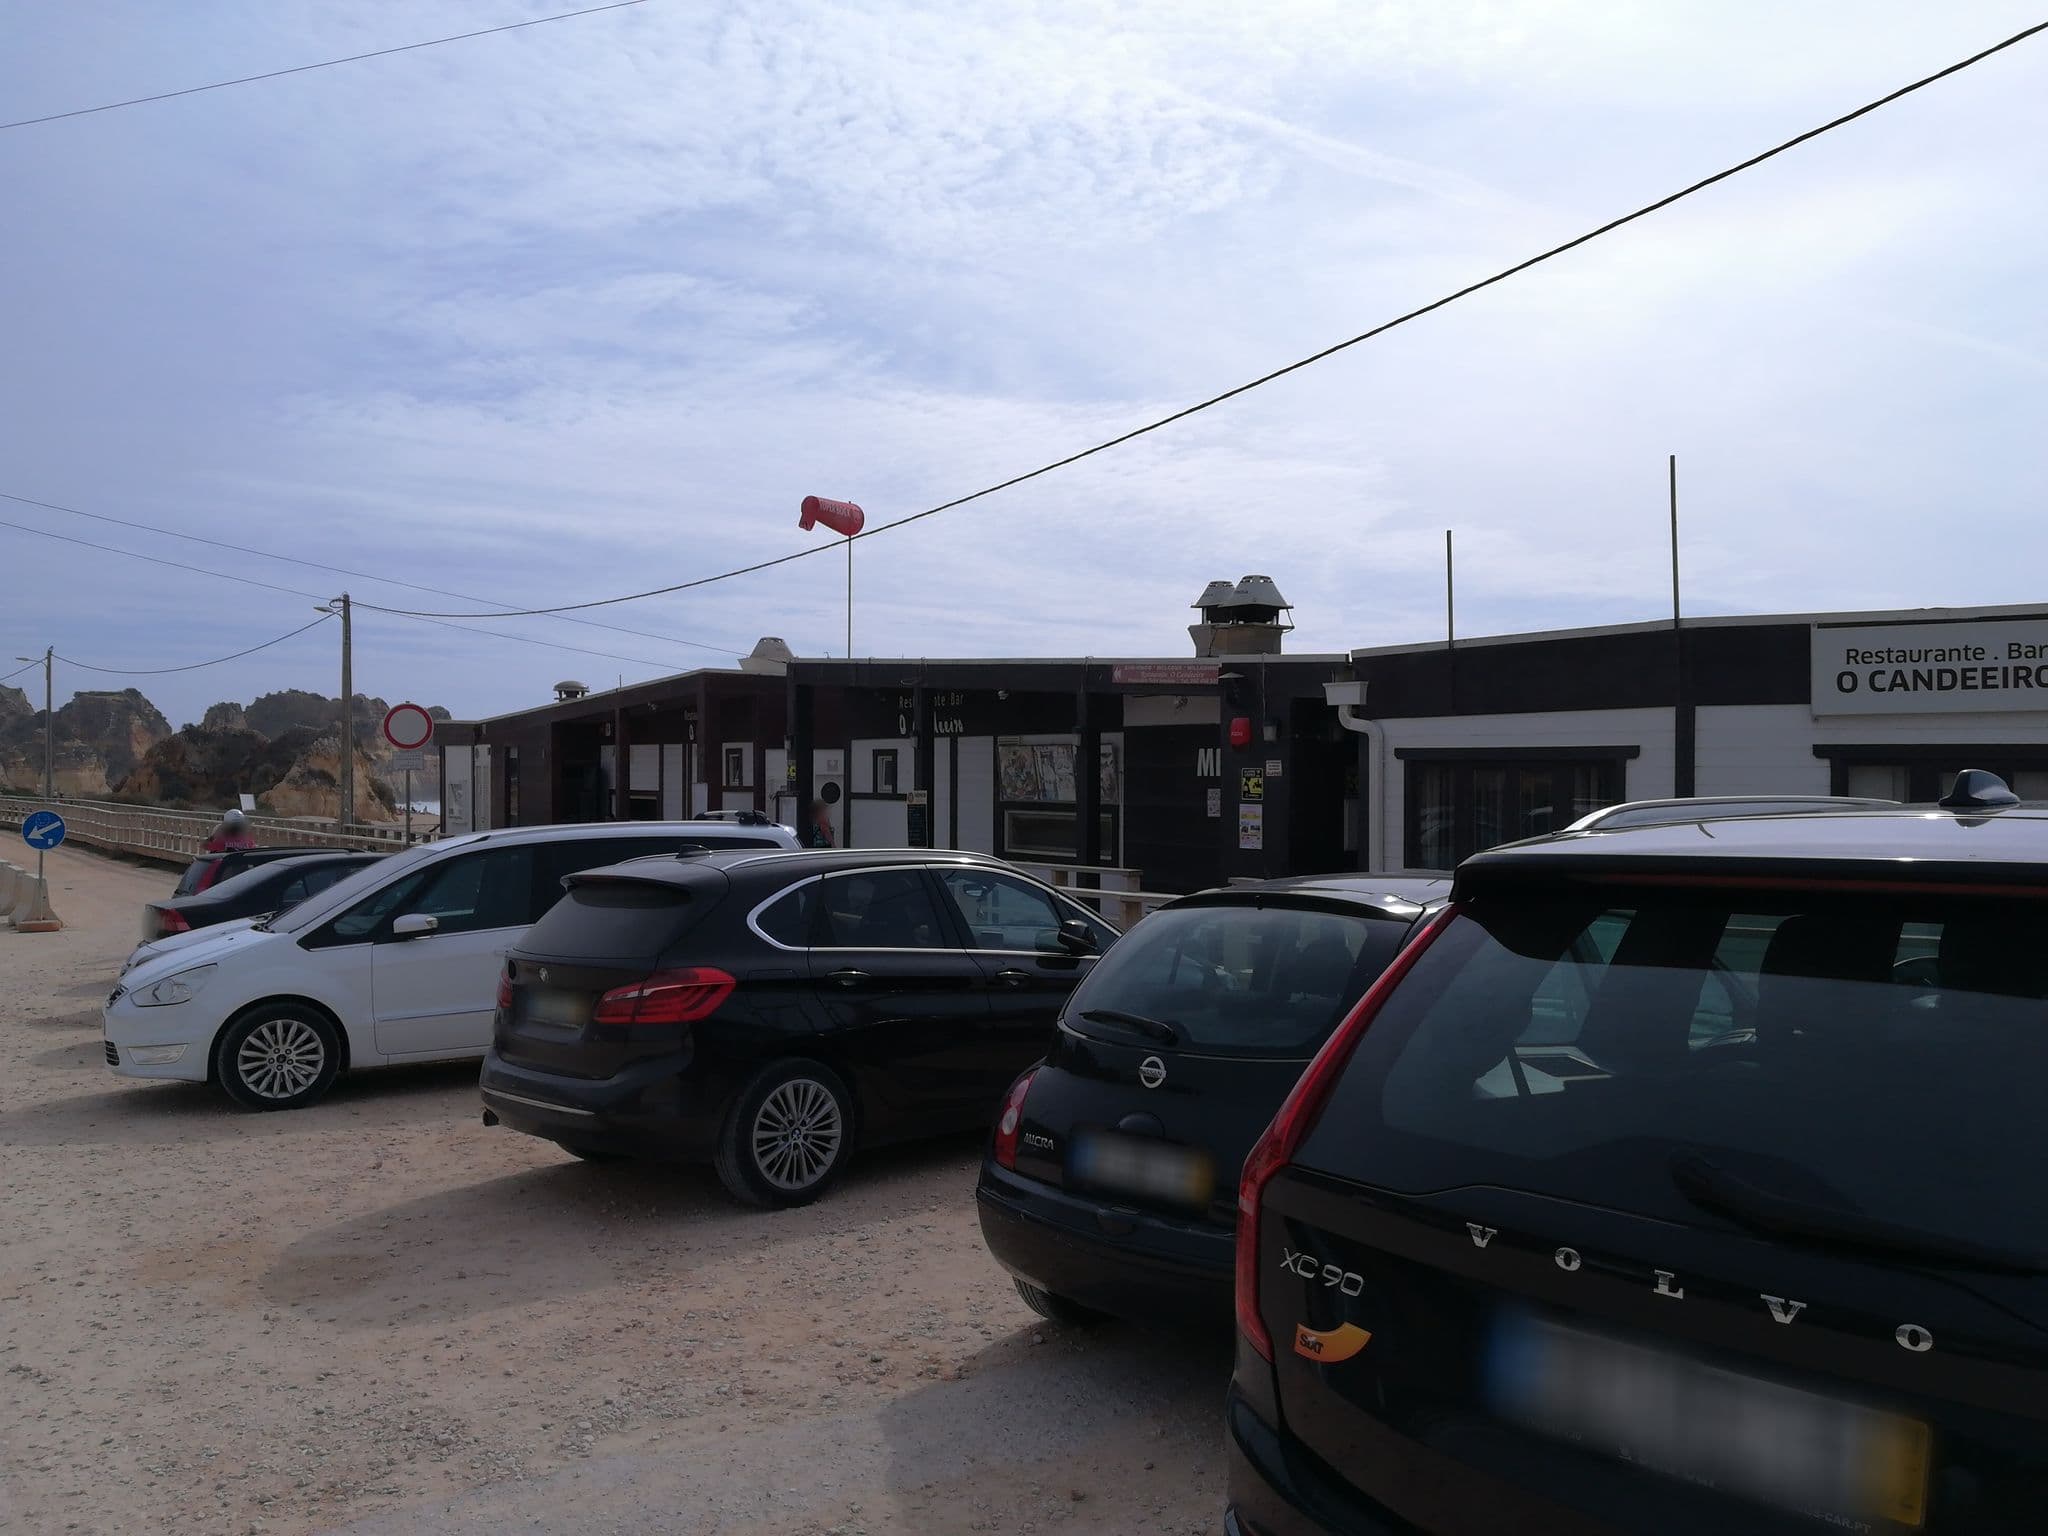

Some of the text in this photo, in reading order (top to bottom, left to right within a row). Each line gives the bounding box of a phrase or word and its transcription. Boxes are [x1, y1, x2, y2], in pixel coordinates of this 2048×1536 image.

[1846, 642, 2048, 665] Restaurante Bar
[1836, 664, 2048, 694] O CANDEEIRO
[1023, 1132, 1054, 1150] MICRA
[1465, 1221, 1934, 1352] VOLVO
